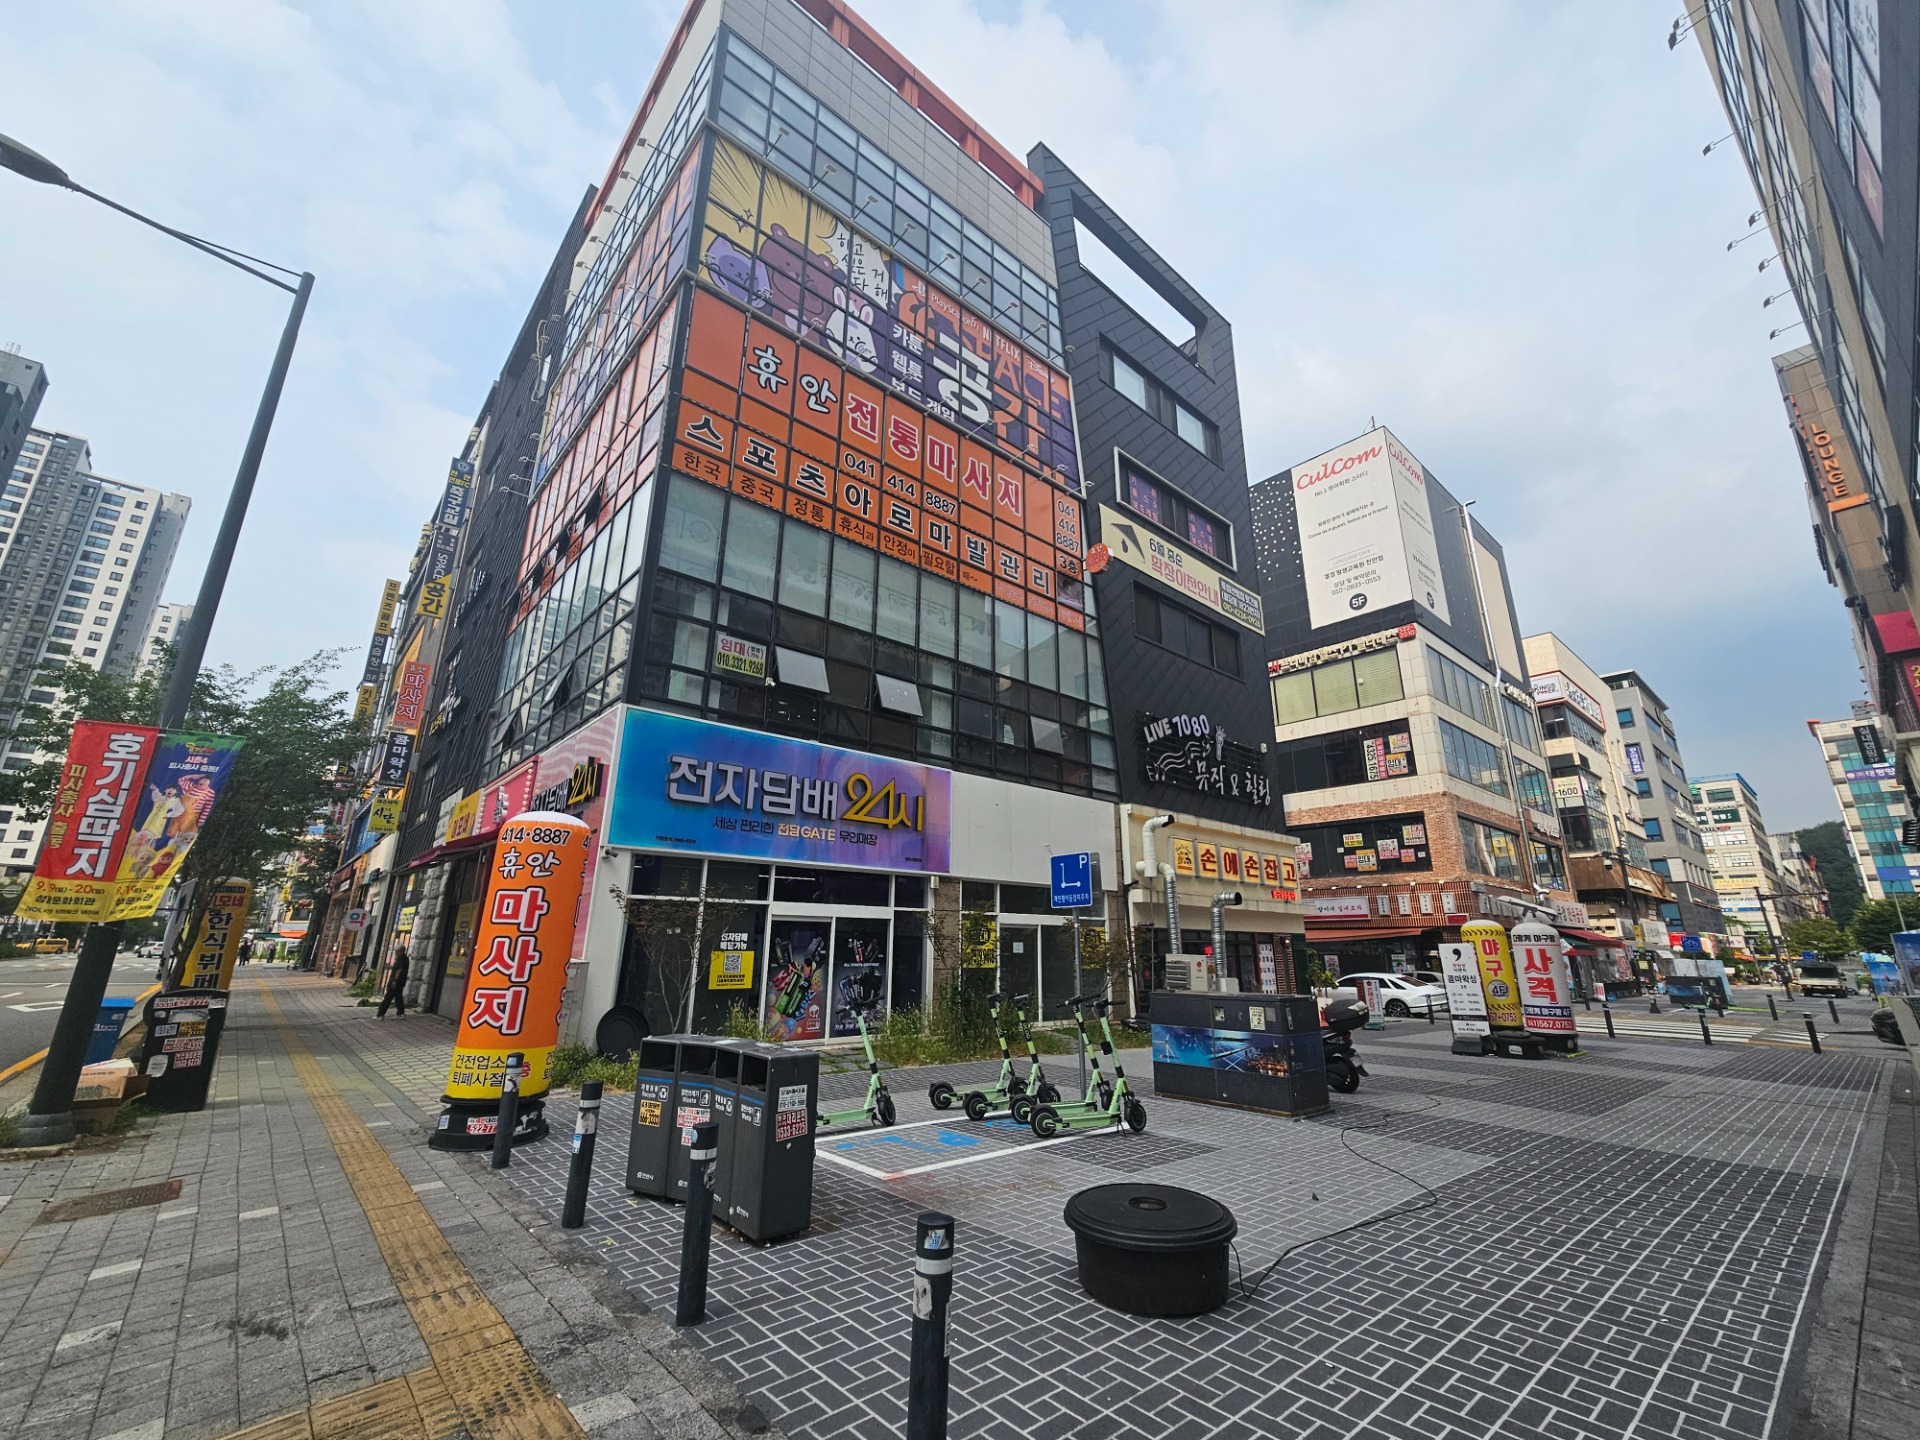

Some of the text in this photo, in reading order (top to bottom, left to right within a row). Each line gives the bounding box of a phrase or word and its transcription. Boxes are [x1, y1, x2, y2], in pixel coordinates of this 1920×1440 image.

[893, 325, 923, 356] 카툰
[845, 392, 1023, 516] 전통마사지
[1809, 423, 1849, 498] LOUNGE
[843, 450, 958, 517] 041 414 8887
[683, 450, 722, 484] 한국
[739, 474, 776, 505] 중국
[793, 496, 826, 525] 정통
[838, 515, 876, 545] 휴식과
[883, 532, 918, 561] 안정이
[921, 549, 957, 580] 필요할
[1057, 500, 1076, 520] 041
[1058, 518, 1077, 535] 414
[1056, 532, 1080, 553] 8887
[432, 552, 449, 581] SPACE
[1059, 555, 1079, 575] 3층
[1151, 554, 1220, 607] 확장이전안내
[1351, 596, 1366, 608] 5F
[720, 638, 747, 656] 임대
[717, 652, 764, 676] 010.3321.9268
[396, 672, 425, 720] 마사지
[1143, 714, 1211, 744] LIVE 7080
[387, 733, 410, 781] 콤마왁싱
[668, 754, 925, 832] 전자담배 24시
[1195, 760, 1225, 795] 뮤직
[1245, 770, 1271, 806] 힐링
[66, 732, 146, 880] 호기심딱지
[712, 816, 878, 847] 세상 편리한 전담GATE 무인매장
[498, 846, 562, 879] 휴안
[1078, 854, 1088, 869] P
[1199, 848, 1298, 883] 손에손잡고
[468, 886, 549, 1036] 마사지
[1480, 938, 1504, 977] 야구
[1491, 984, 1509, 996] 4F
[1523, 948, 1559, 1005] 사격
[455, 1054, 506, 1070] 건전업소
[452, 1071, 506, 1088] 퇴폐사절
[777, 1121, 806, 1139] 1533-6225
